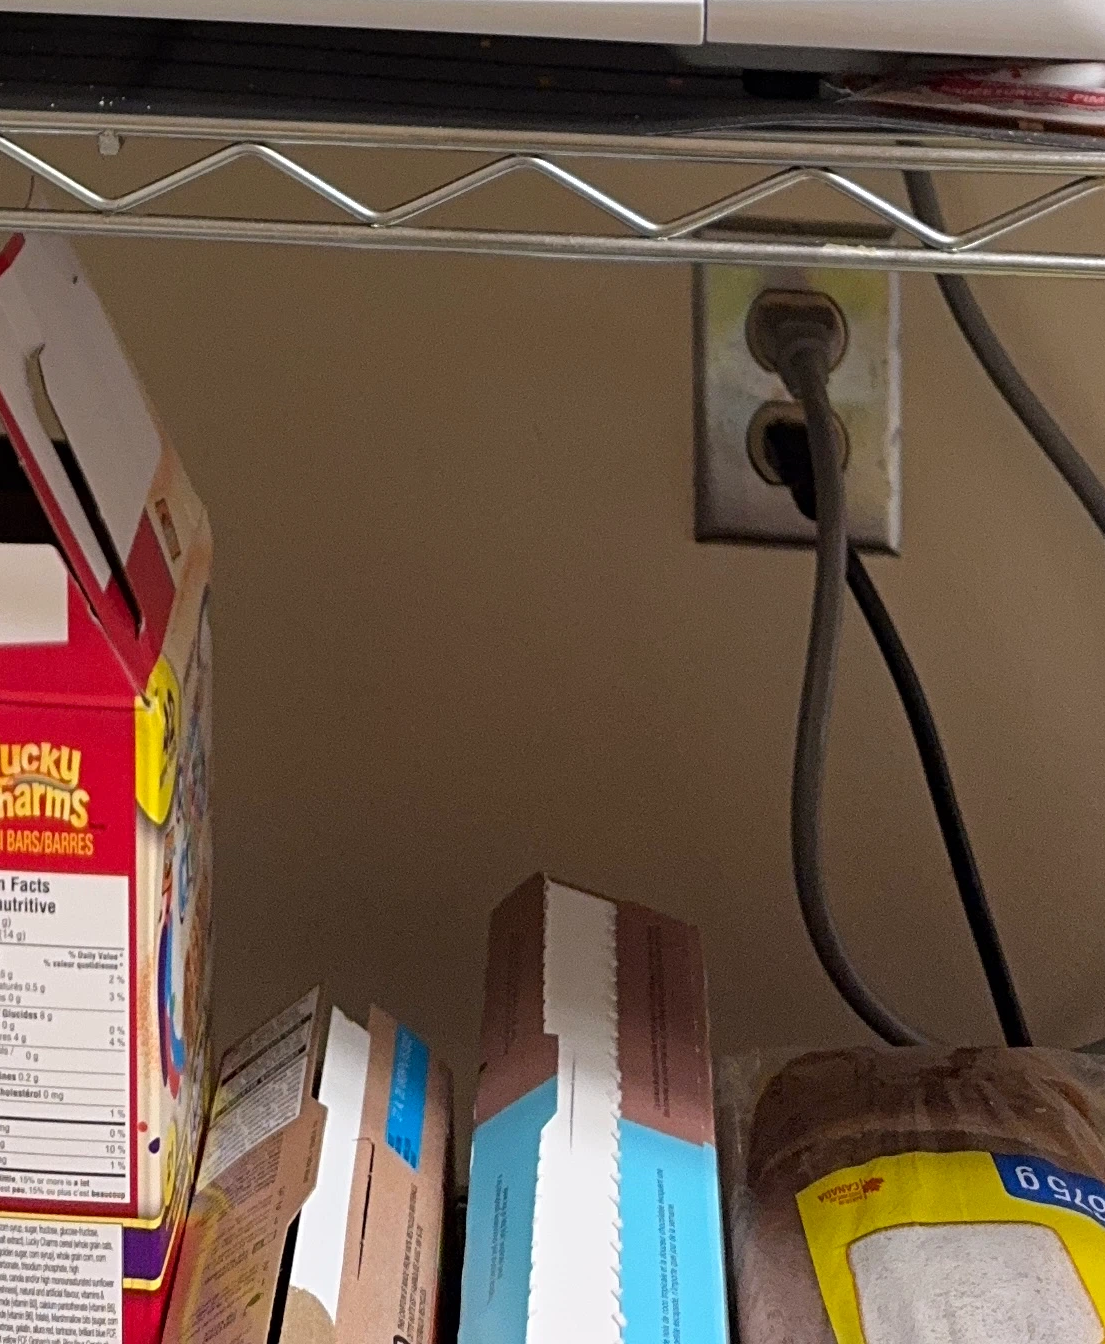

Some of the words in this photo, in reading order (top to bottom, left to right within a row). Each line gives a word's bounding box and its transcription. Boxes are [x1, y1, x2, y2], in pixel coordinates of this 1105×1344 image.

[7, 830, 93, 855] BARS/BARRES
[11, 877, 50, 894] Facts
[2, 916, 11, 927] g)
[17, 931, 26, 942] g)
[51, 1092, 64, 1101] mg
[106, 1144, 115, 1153] 10
[1015, 1166, 1040, 1190] g
[818, 1182, 859, 1203] CANADA
